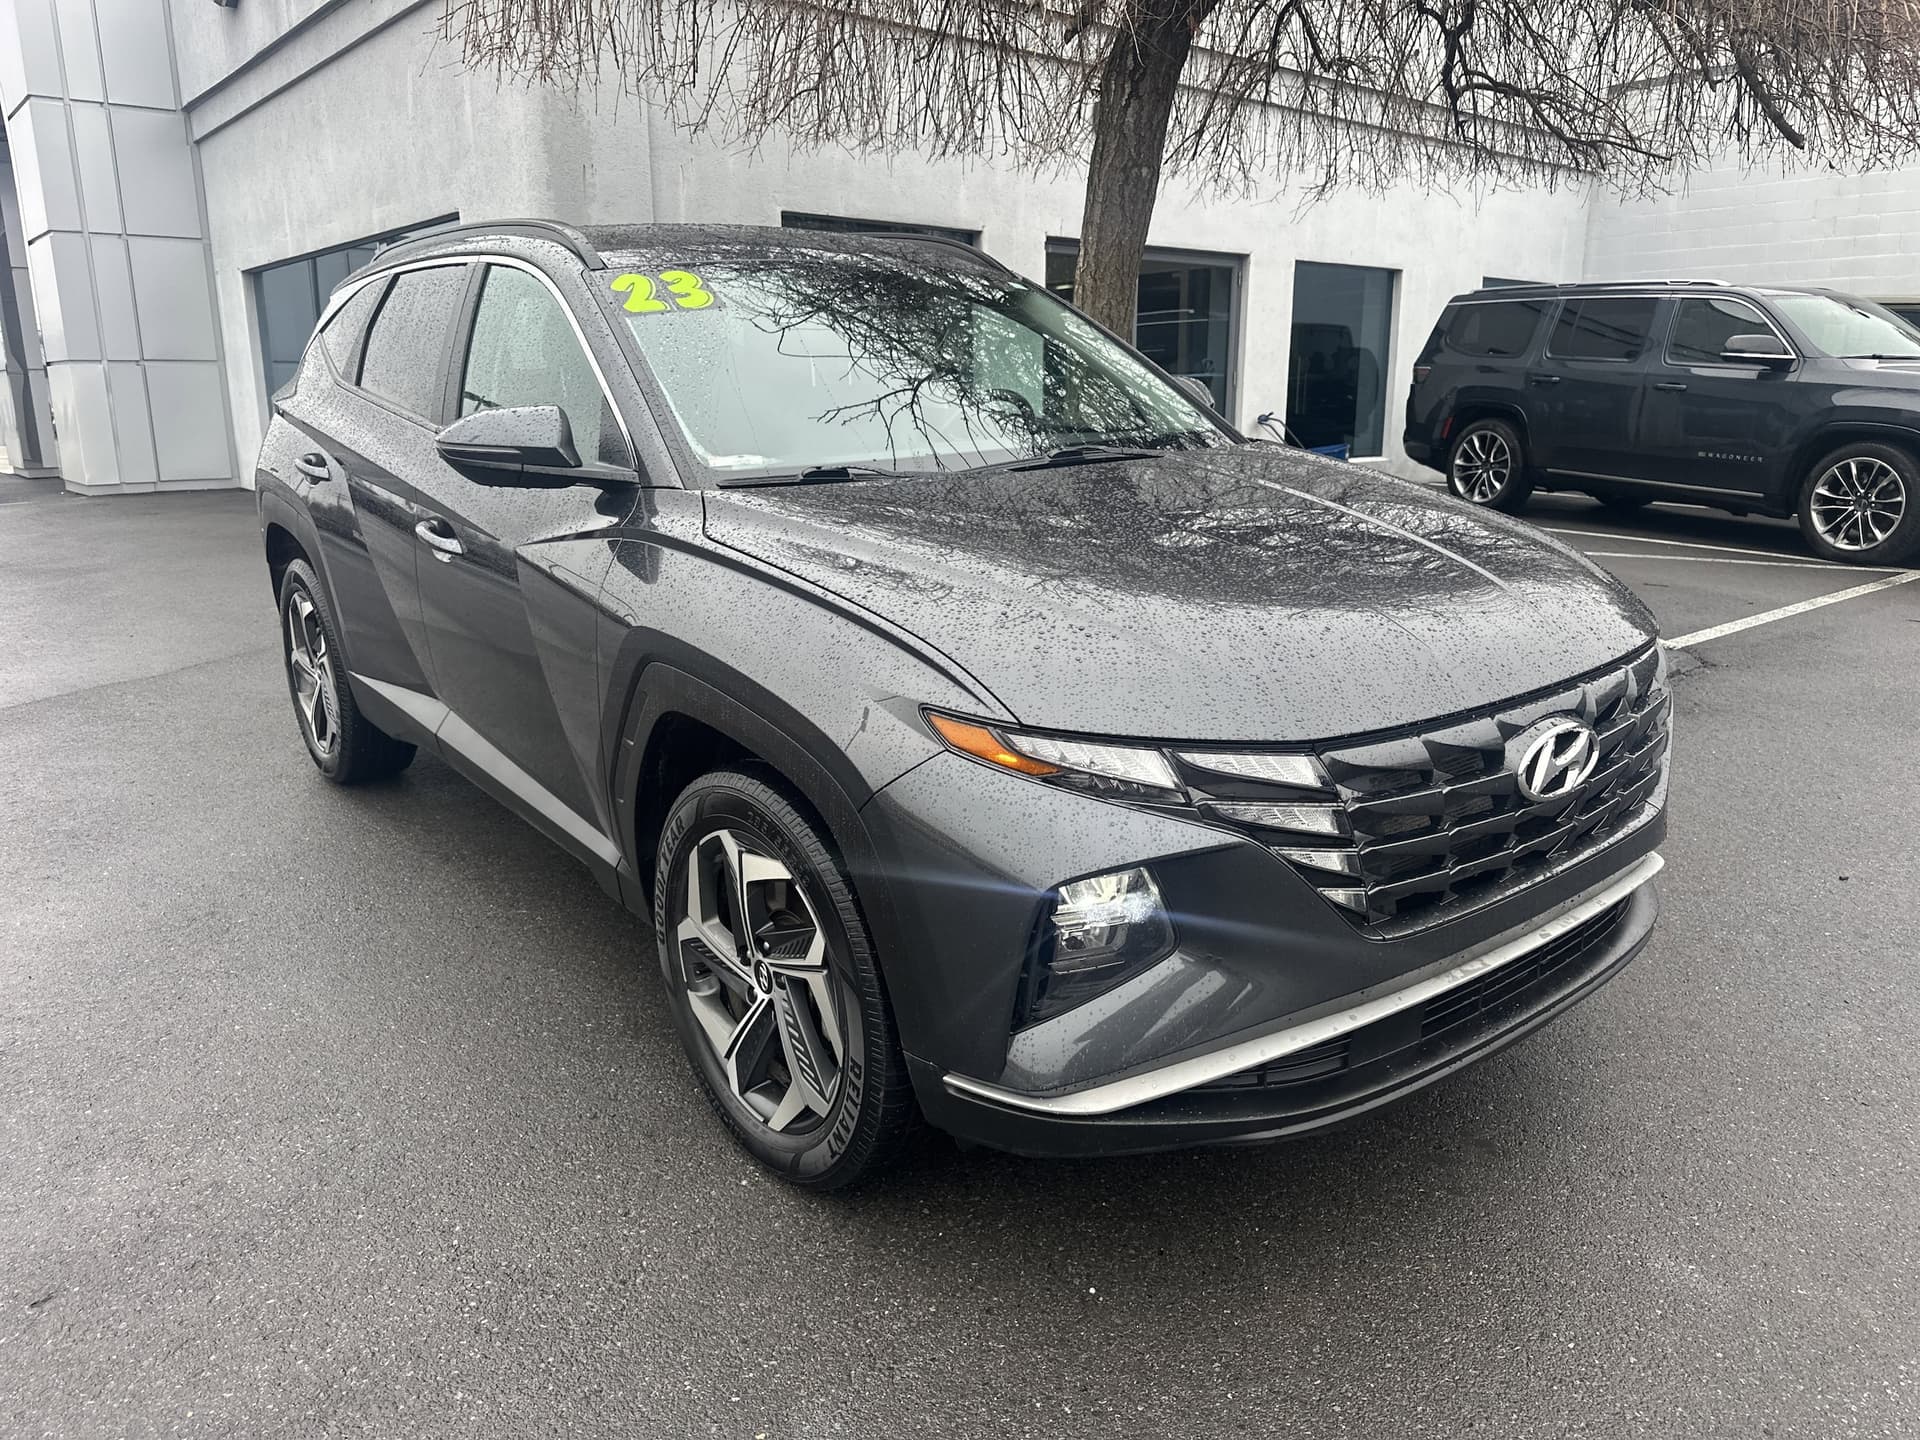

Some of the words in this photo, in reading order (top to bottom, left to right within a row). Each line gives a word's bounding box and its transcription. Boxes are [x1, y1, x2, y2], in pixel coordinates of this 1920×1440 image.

[610, 270, 714, 312] 23
[655, 815, 686, 945] GOODYEAR
[827, 1055, 863, 1160] RELIANT
